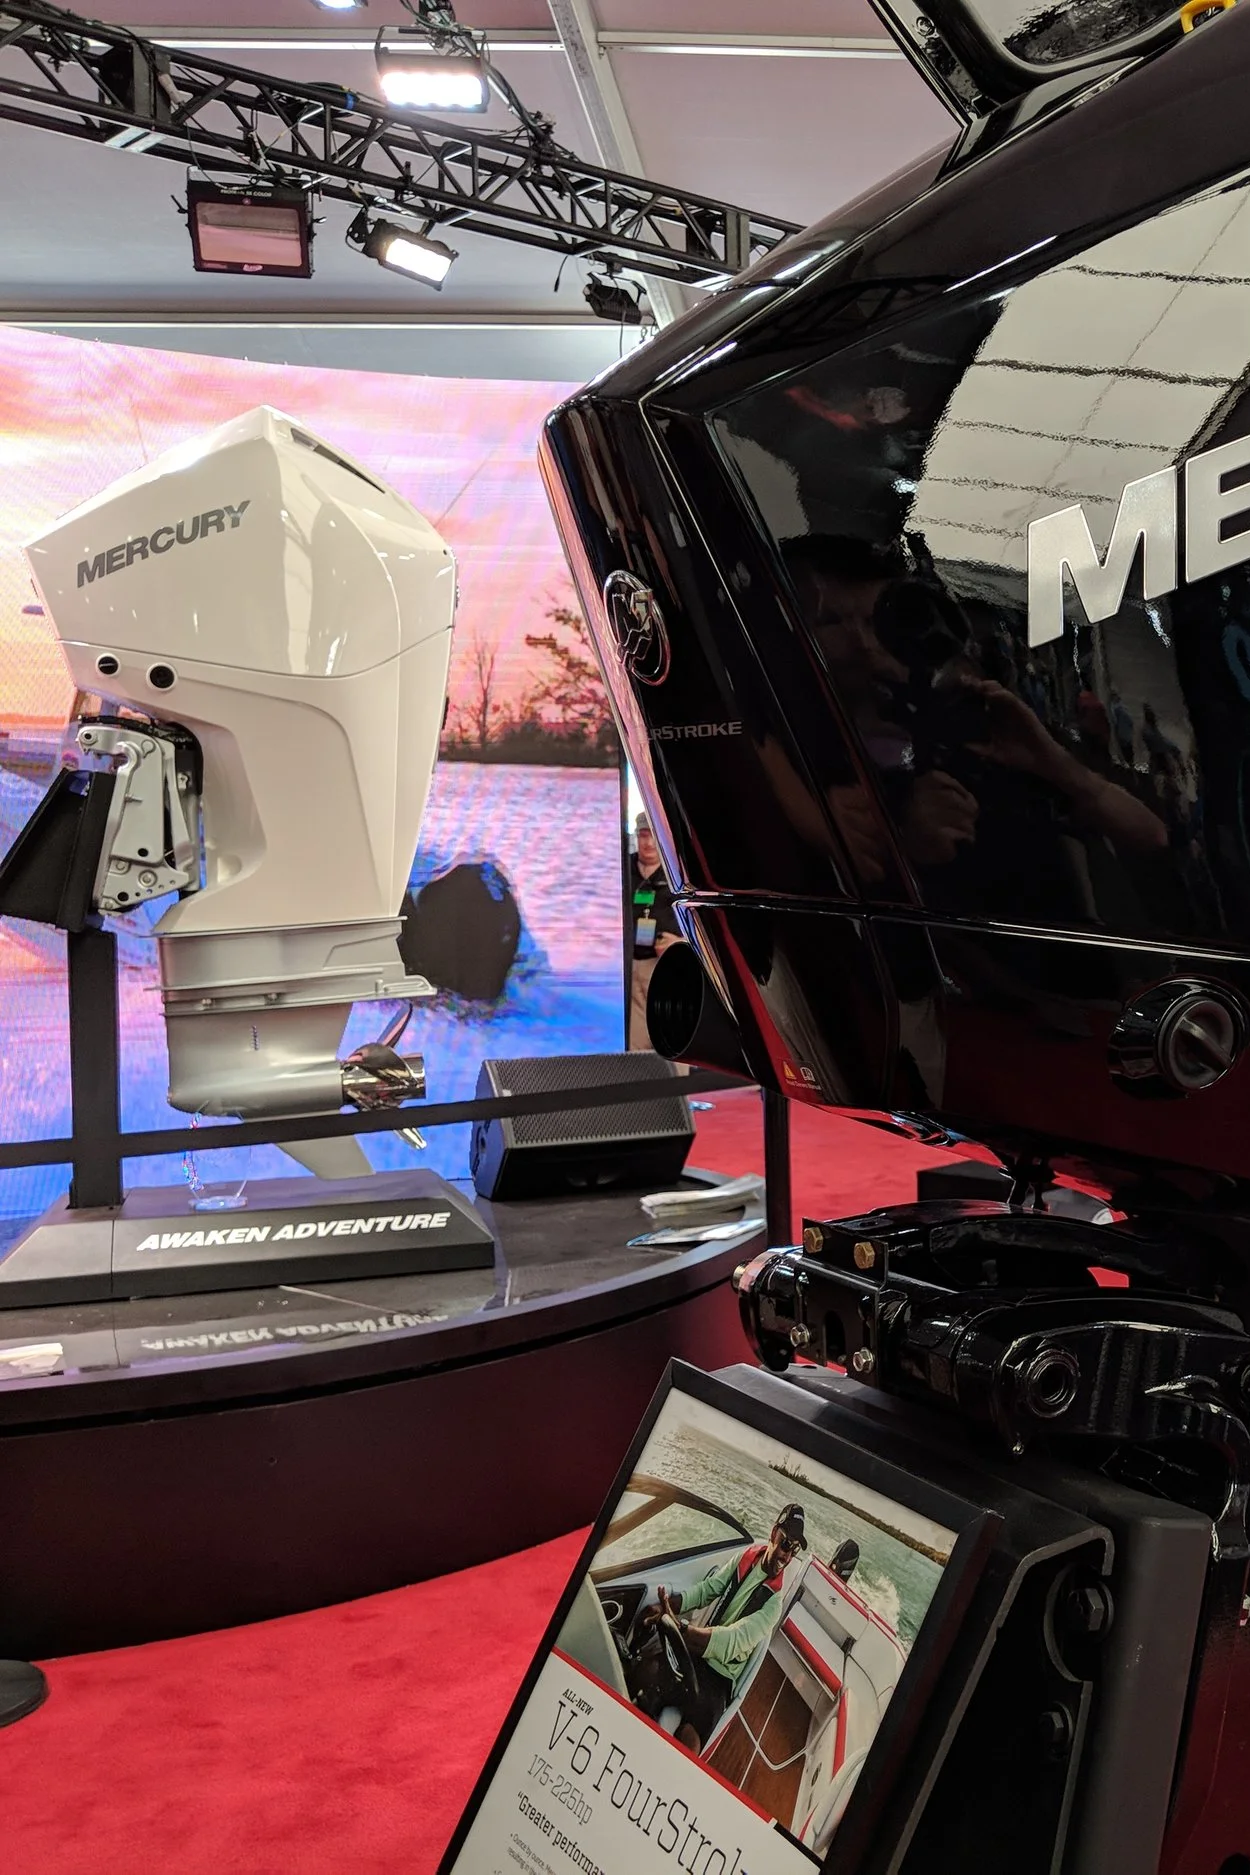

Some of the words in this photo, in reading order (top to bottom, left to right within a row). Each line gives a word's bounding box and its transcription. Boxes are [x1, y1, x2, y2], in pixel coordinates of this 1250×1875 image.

[77, 500, 250, 588] MERCURY
[136, 1225, 272, 1252] AWAKEN
[271, 1211, 451, 1242] ADVENTURE
[562, 1688, 594, 1716] ALL-NEW
[548, 1700, 600, 1775] V-6
[528, 1754, 593, 1826] 175-225hp
[552, 1830, 605, 1875] performa
